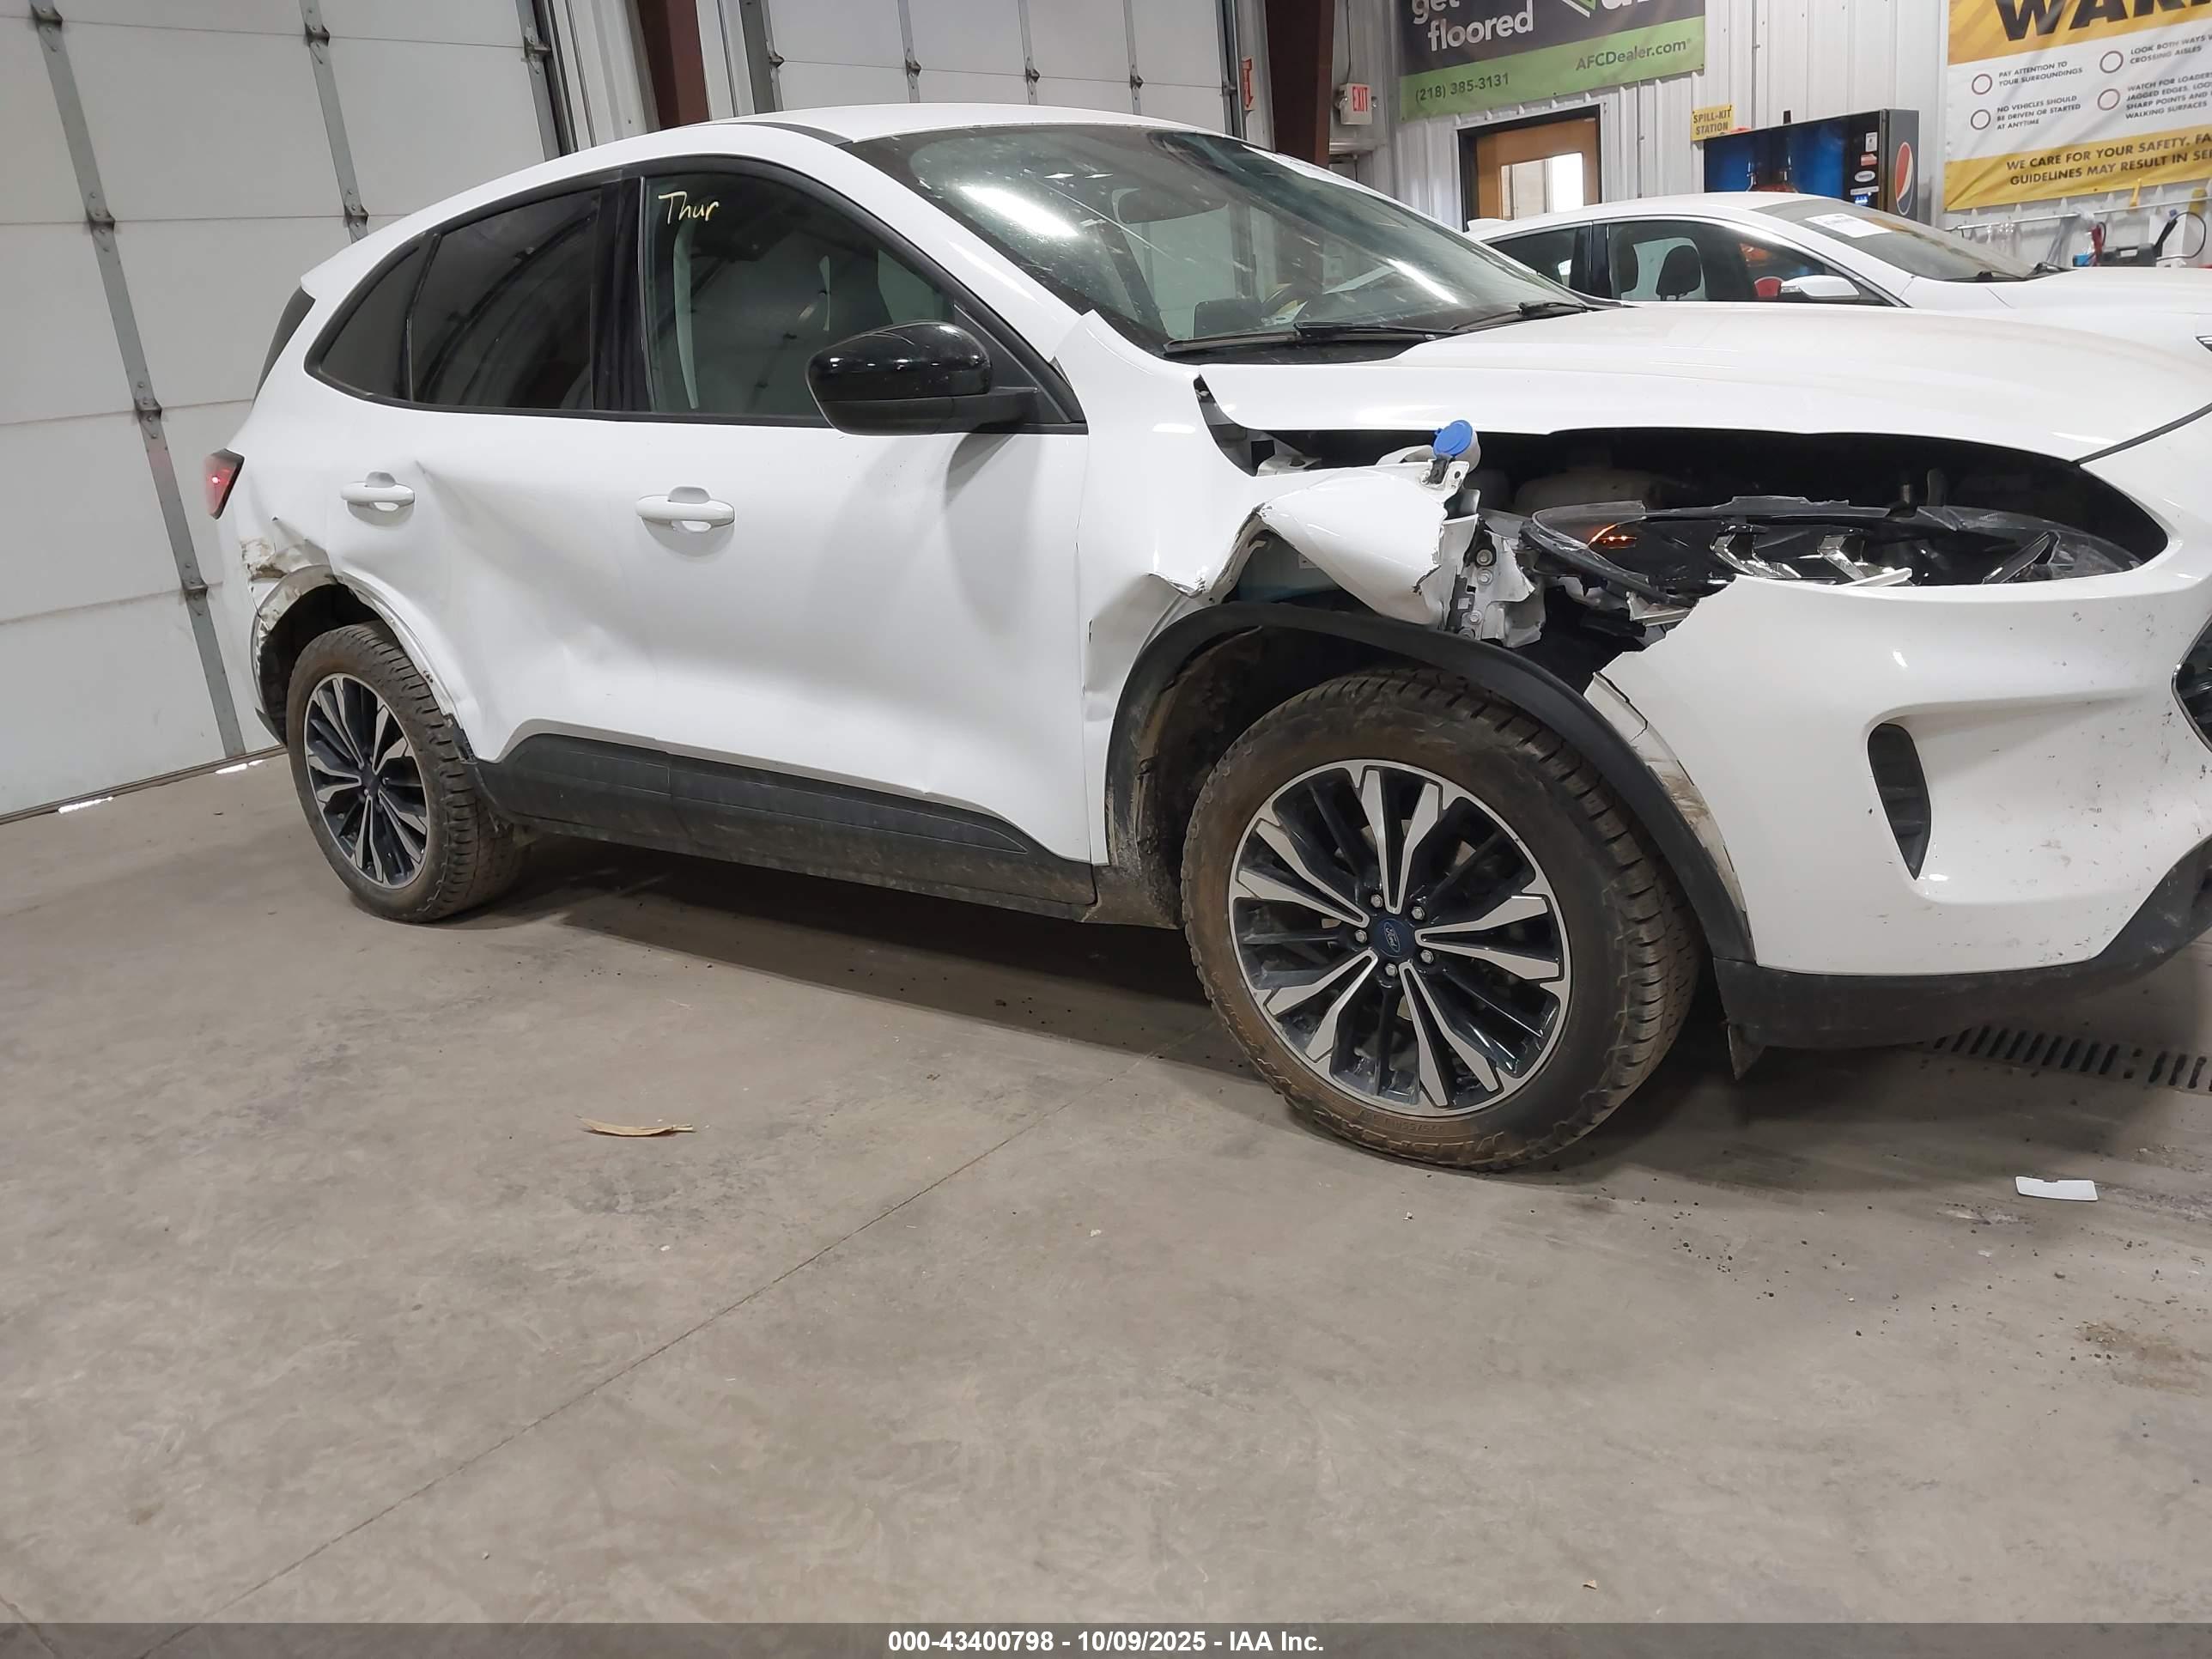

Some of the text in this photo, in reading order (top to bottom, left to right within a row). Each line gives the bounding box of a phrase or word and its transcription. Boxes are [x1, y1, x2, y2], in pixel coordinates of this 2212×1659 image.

[1428, 0, 1534, 52] floored
[2130, 45, 2154, 55] LOOK
[2156, 40, 2179, 50] BOTH
[2182, 34, 2205, 44] WAYS
[1576, 40, 1686, 70] AFCDealer.com
[2130, 46, 2202, 64] CROSSING AISLES
[1999, 67, 2083, 87] YOUR SURROUNDINGS
[2014, 63, 2056, 76] ATTENTION
[1416, 72, 1509, 103] (218) 385-3131
[2128, 82, 2156, 91] WATCH
[2178, 71, 2212, 82] LOADER
[1352, 87, 1368, 112] EXIT
[1997, 95, 2077, 113] NO VEHICLES SHOULD
[2125, 91, 2208, 110] SHARP POINTS AND
[2126, 89, 2159, 101] JAGGED
[1693, 109, 1730, 124] SPILL-KIT
[2008, 111, 2034, 120] DRIVEN
[2050, 103, 2081, 114] STARTED
[2125, 100, 2207, 119] WALKING SURFACES
[1696, 122, 1729, 135] STATION
[2008, 118, 2039, 129] ANYTIME
[2007, 160, 2026, 171] WE
[2029, 155, 2061, 168] CARE
[2065, 151, 2091, 163] FOR
[2096, 144, 2134, 159] YOUR
[2137, 136, 2191, 153] SAFETY.
[2010, 167, 2082, 185] GUIDELINES
[2087, 163, 2117, 176] MAY
[2120, 155, 2167, 172] RESULT
[2172, 152, 2188, 163] IN
[659, 191, 719, 225] Thur
